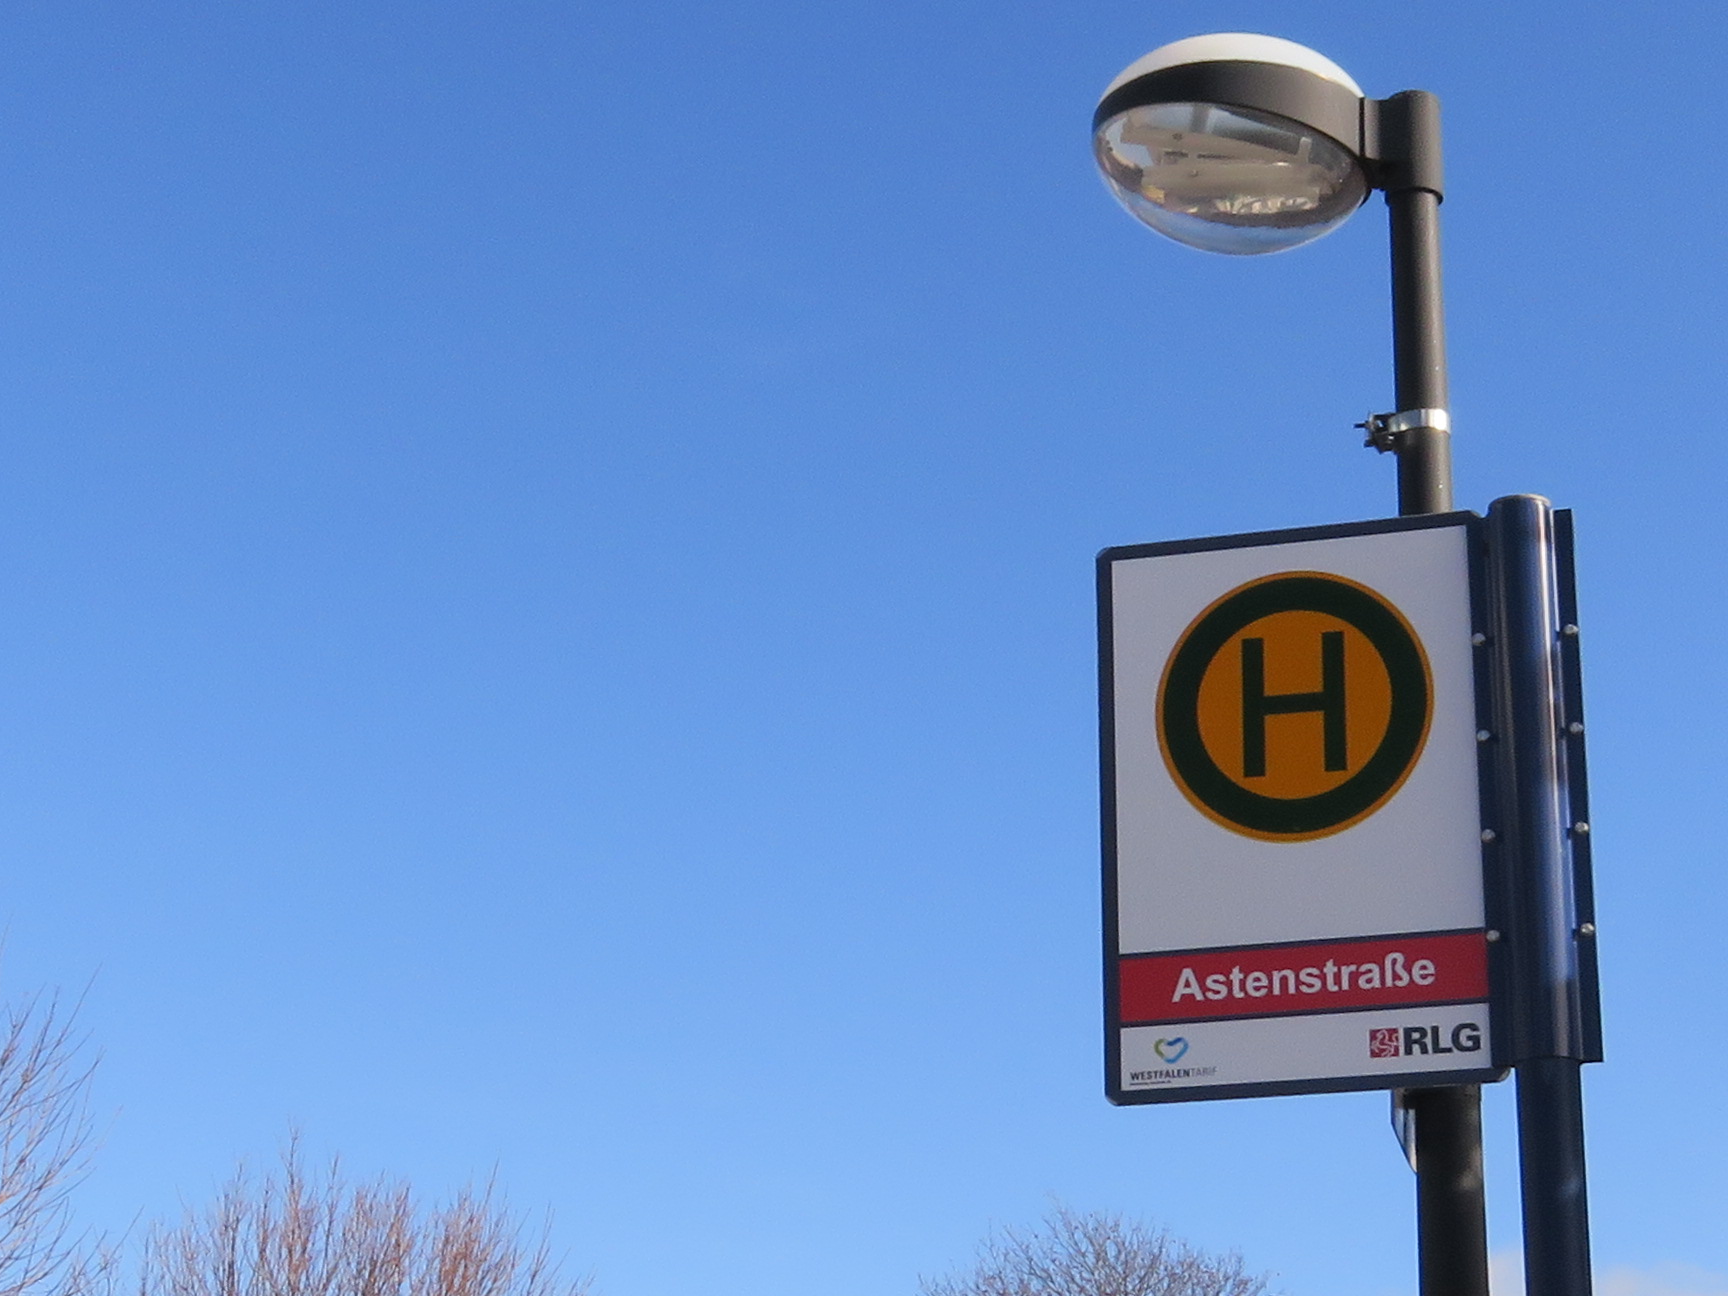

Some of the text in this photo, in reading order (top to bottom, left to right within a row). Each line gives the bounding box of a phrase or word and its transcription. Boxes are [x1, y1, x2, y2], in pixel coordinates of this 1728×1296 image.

[1241, 629, 1348, 779] H
[1171, 952, 1437, 1003] Astenstraße
[1402, 1022, 1482, 1055] RLG
[1129, 1066, 1218, 1081] WESTFALENTARIF
